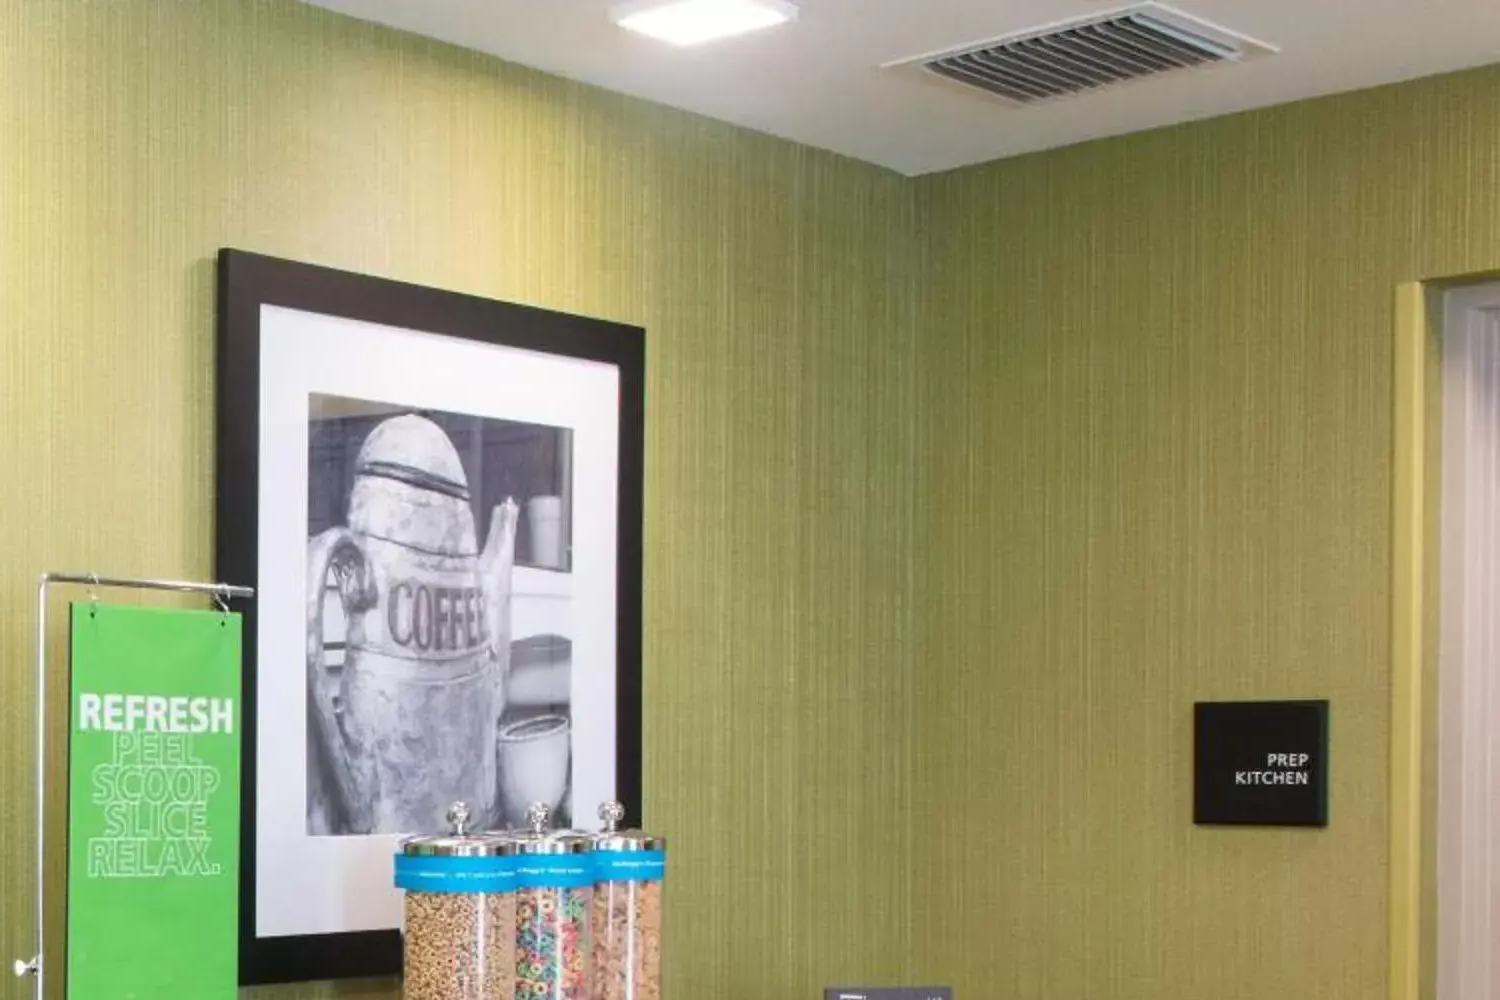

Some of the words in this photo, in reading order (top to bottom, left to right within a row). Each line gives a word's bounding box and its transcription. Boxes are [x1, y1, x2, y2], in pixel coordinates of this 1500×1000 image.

[387, 583, 486, 651] COFFEE
[79, 693, 234, 734] REFRESH
[112, 729, 202, 768] PEEL
[1267, 753, 1309, 767] PREP
[92, 763, 221, 805] SCOOP
[1235, 771, 1309, 785] KITCHEN
[103, 800, 208, 841] SLICE
[87, 836, 221, 878] RELAX.
